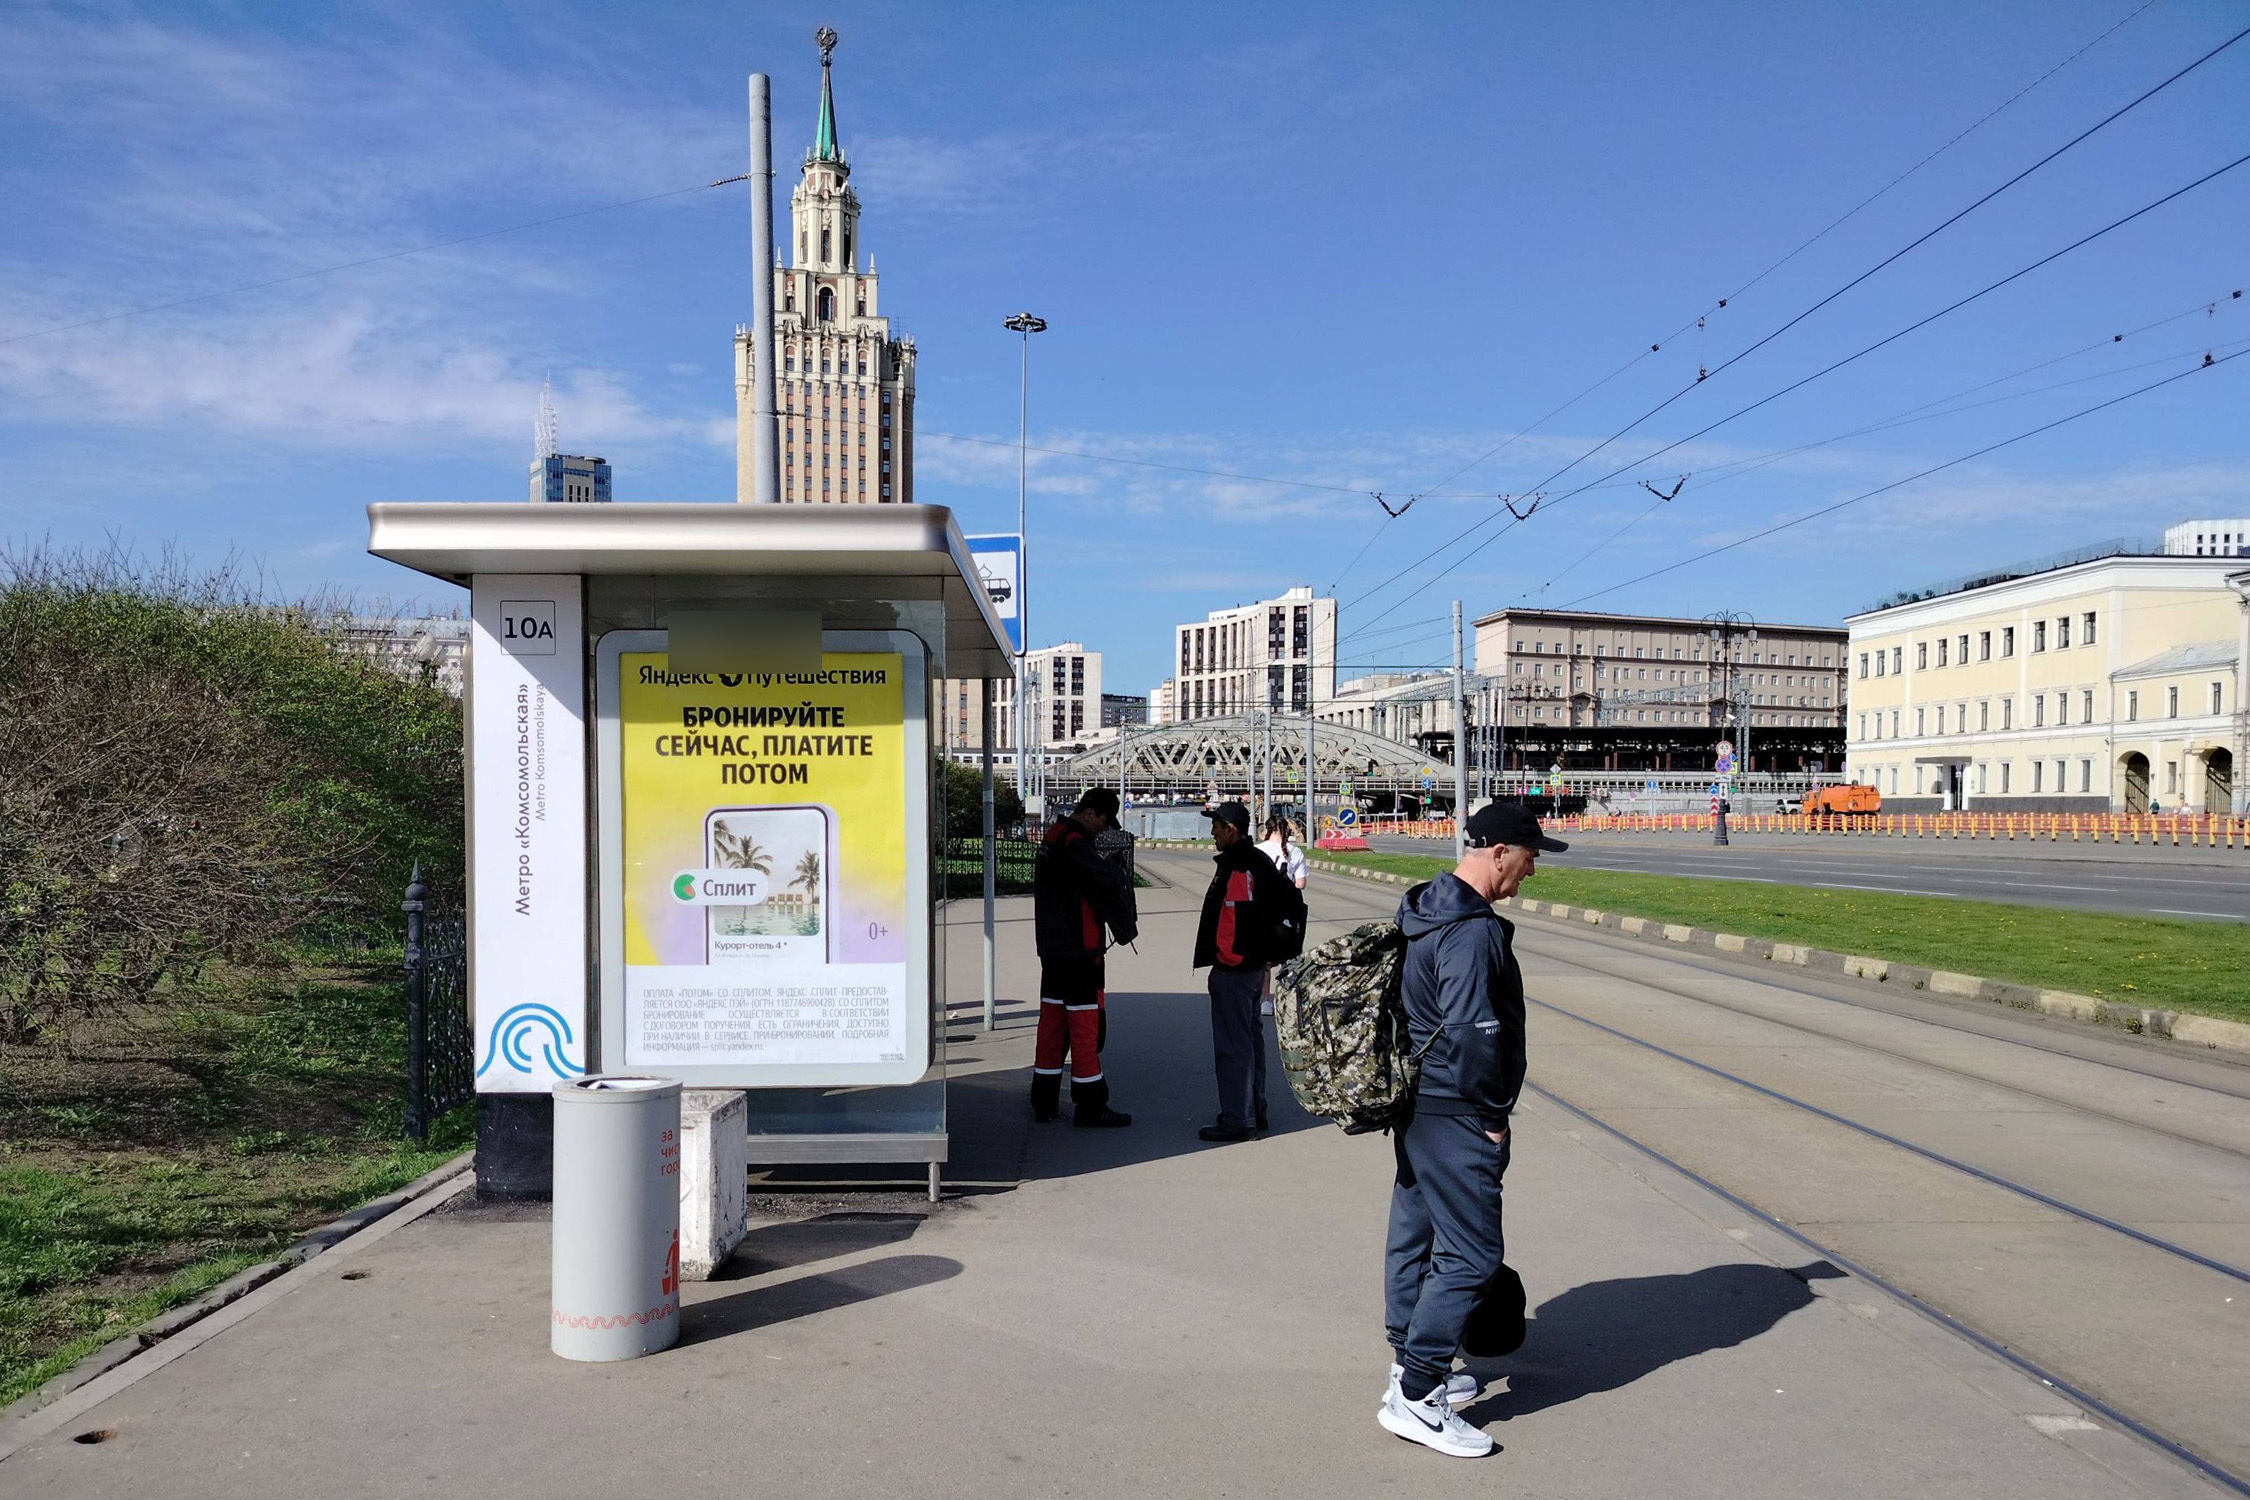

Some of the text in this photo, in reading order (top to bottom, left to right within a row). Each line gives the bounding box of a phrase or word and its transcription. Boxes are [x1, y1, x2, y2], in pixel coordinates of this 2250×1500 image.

[639, 665, 713, 687] Яндекс
[682, 701, 845, 728] БРОНИРУЙТЕ
[655, 729, 873, 759] СЕЙЧАС, ПЛАТИТЕ
[534, 683, 546, 822] Metro Komsomolskaya
[721, 763, 808, 785] ПОТОМ
[514, 683, 533, 916] Метро «Комсомольская»
[703, 879, 757, 896] Сплит
[868, 922, 889, 941] 0+
[714, 941, 774, 951] Курорт-отель
[643, 988, 674, 998] ОПЛАТА
[678, 988, 713, 998] «ПОТОМ»
[717, 988, 729, 998] СО
[776, 987, 808, 998] ЯНДЕКС
[811, 987, 838, 997] СПЛИТ
[841, 986, 889, 997] ПРЕДОСТАВ-
[642, 999, 673, 1009] ЛЯЕТСЯ
[674, 999, 692, 1009] ООО
[693, 999, 727, 1010] «ЯНДЕКС
[729, 998, 750, 1008] ПЭЙ»
[751, 998, 774, 1009] (ОГРН
[838, 998, 849, 1007] СО
[851, 997, 889, 1007] СПЛИТОМ
[643, 1008, 889, 1020] БРОНИРОВАНИЕ ОСУЩЕСТВЛЯЕТСЯ В СООТВЕТСТВИИ
[643, 1021, 649, 1030] С
[650, 1021, 699, 1031] ДОГОВОРОМ
[758, 1020, 777, 1029] ЕСТЬ
[846, 1018, 889, 1029] ДОСТУПНО
[643, 1032, 659, 1041] ПРИ
[661, 1031, 700, 1041] НАЛИЧИИ
[704, 1031, 710, 1040] В
[714, 1030, 748, 1040] СЕРВИСЕ
[753, 1031, 770, 1040] ПРИ
[842, 1029, 889, 1040] ПОДРОБНАЯ
[643, 1042, 700, 1053] ИНФОРМАЦИЯ
[661, 1129, 673, 1143] за
